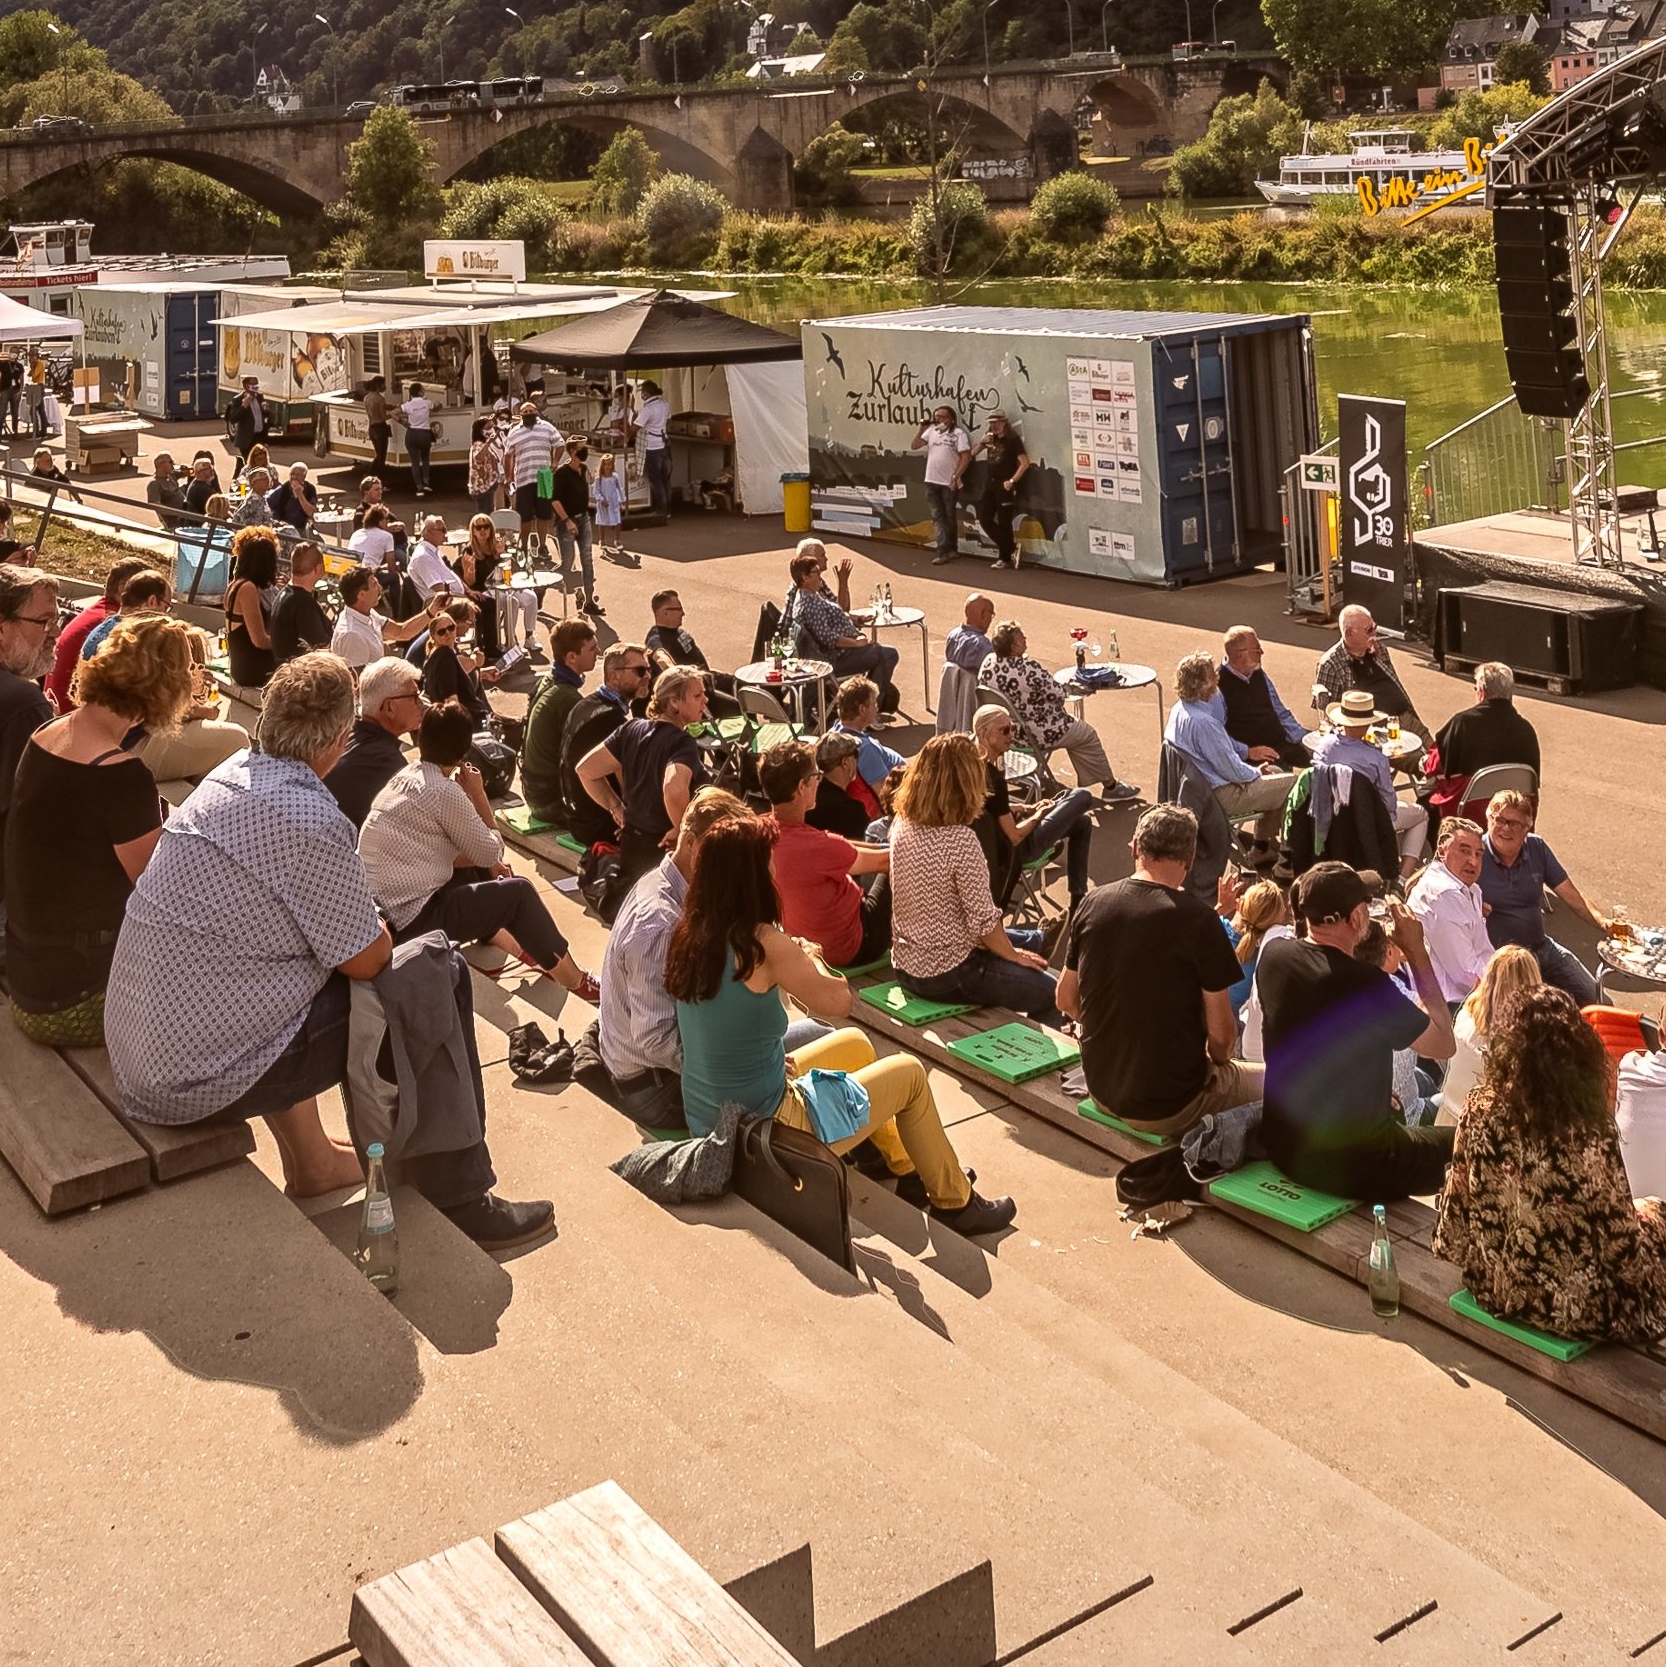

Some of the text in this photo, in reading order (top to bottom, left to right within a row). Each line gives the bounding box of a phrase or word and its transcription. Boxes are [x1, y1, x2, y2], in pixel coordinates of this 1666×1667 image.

[1357, 176, 1420, 217] Bitte
[1424, 166, 1463, 191] ein
[46, 275, 73, 285] Tickets
[866, 360, 1000, 415] Kulturhafen
[846, 391, 933, 426] Zurlaub
[344, 418, 372, 444] Bitburg
[1374, 515, 1394, 536] 30
[1375, 535, 1393, 548] TRIER
[1259, 1181, 1302, 1201] LOTTO
